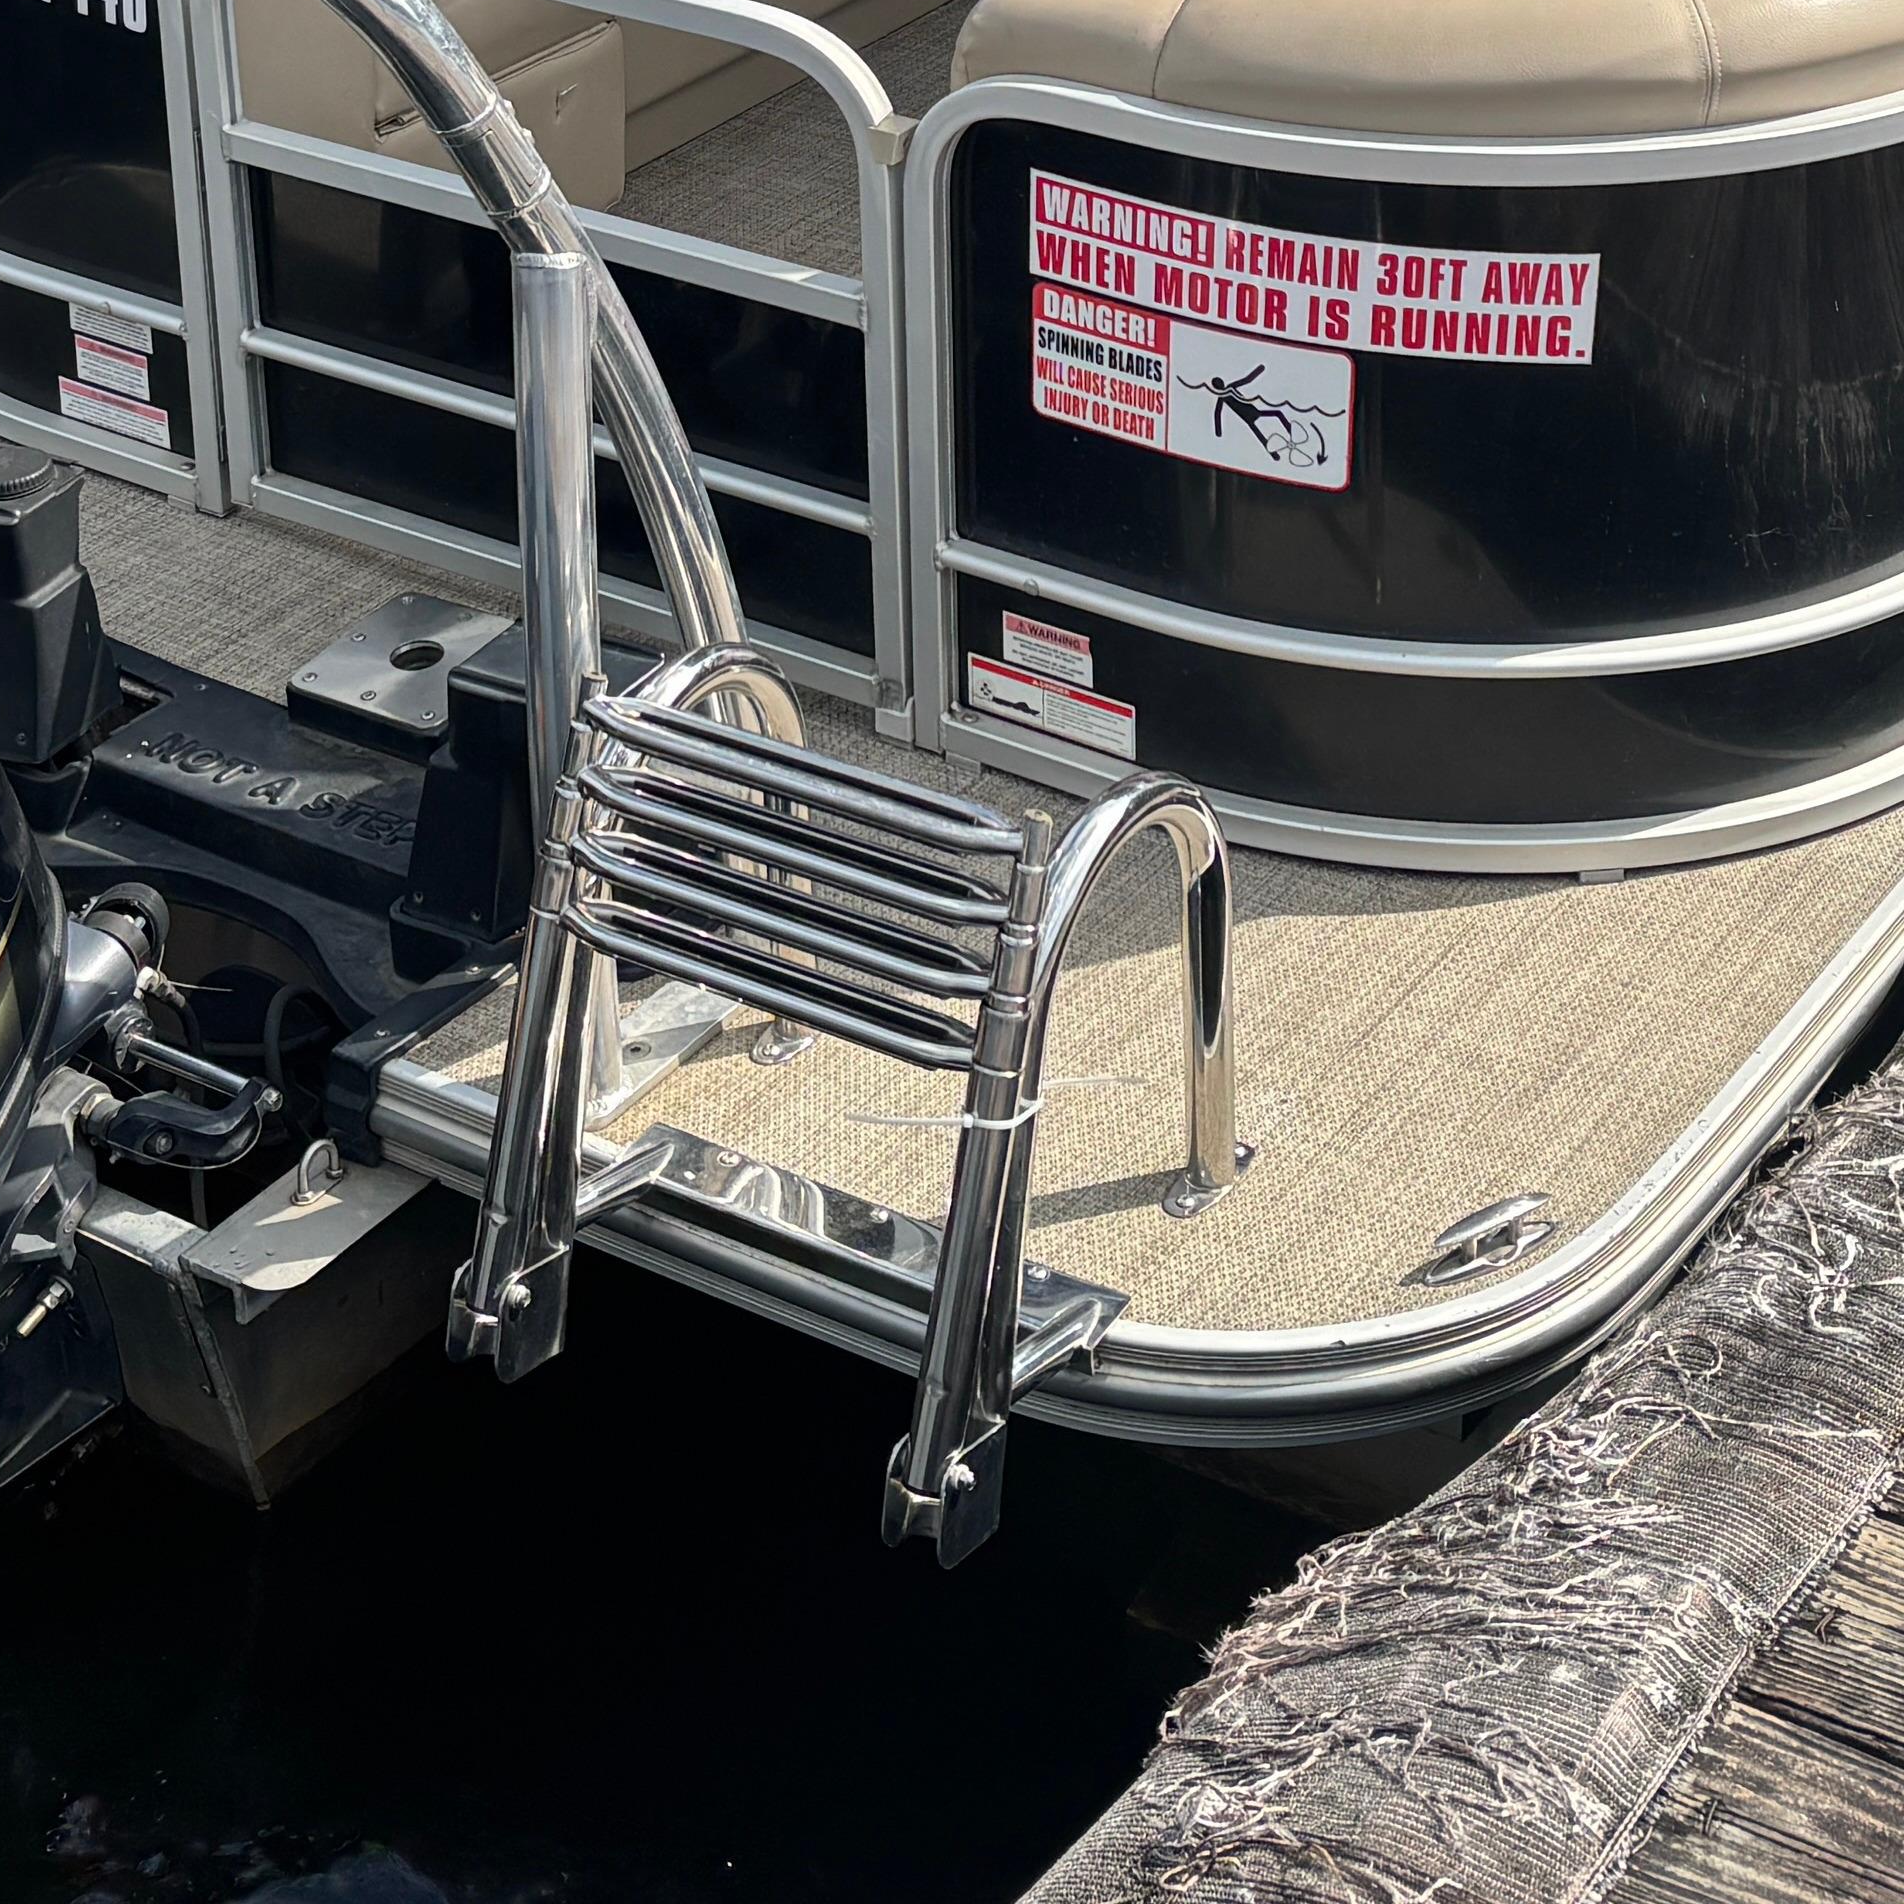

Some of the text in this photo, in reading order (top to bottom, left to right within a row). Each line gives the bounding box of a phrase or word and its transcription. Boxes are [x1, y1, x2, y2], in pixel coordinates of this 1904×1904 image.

[1042, 184, 1590, 306] WARNING! REMAIN 30FT AWAY
[1036, 231, 1586, 358] WHEN MOTOR IS RUNNING.
[1044, 289, 1155, 347] DANGER!
[1038, 326, 1162, 382] SPINNING BLADES
[1037, 355, 1163, 415] WILL CAUSE SERIOUS
[1044, 386, 1154, 440] INJURY OR DEATH
[1028, 625, 1081, 650] WARNING
[145, 732, 260, 783] NOT
[248, 777, 299, 805] A
